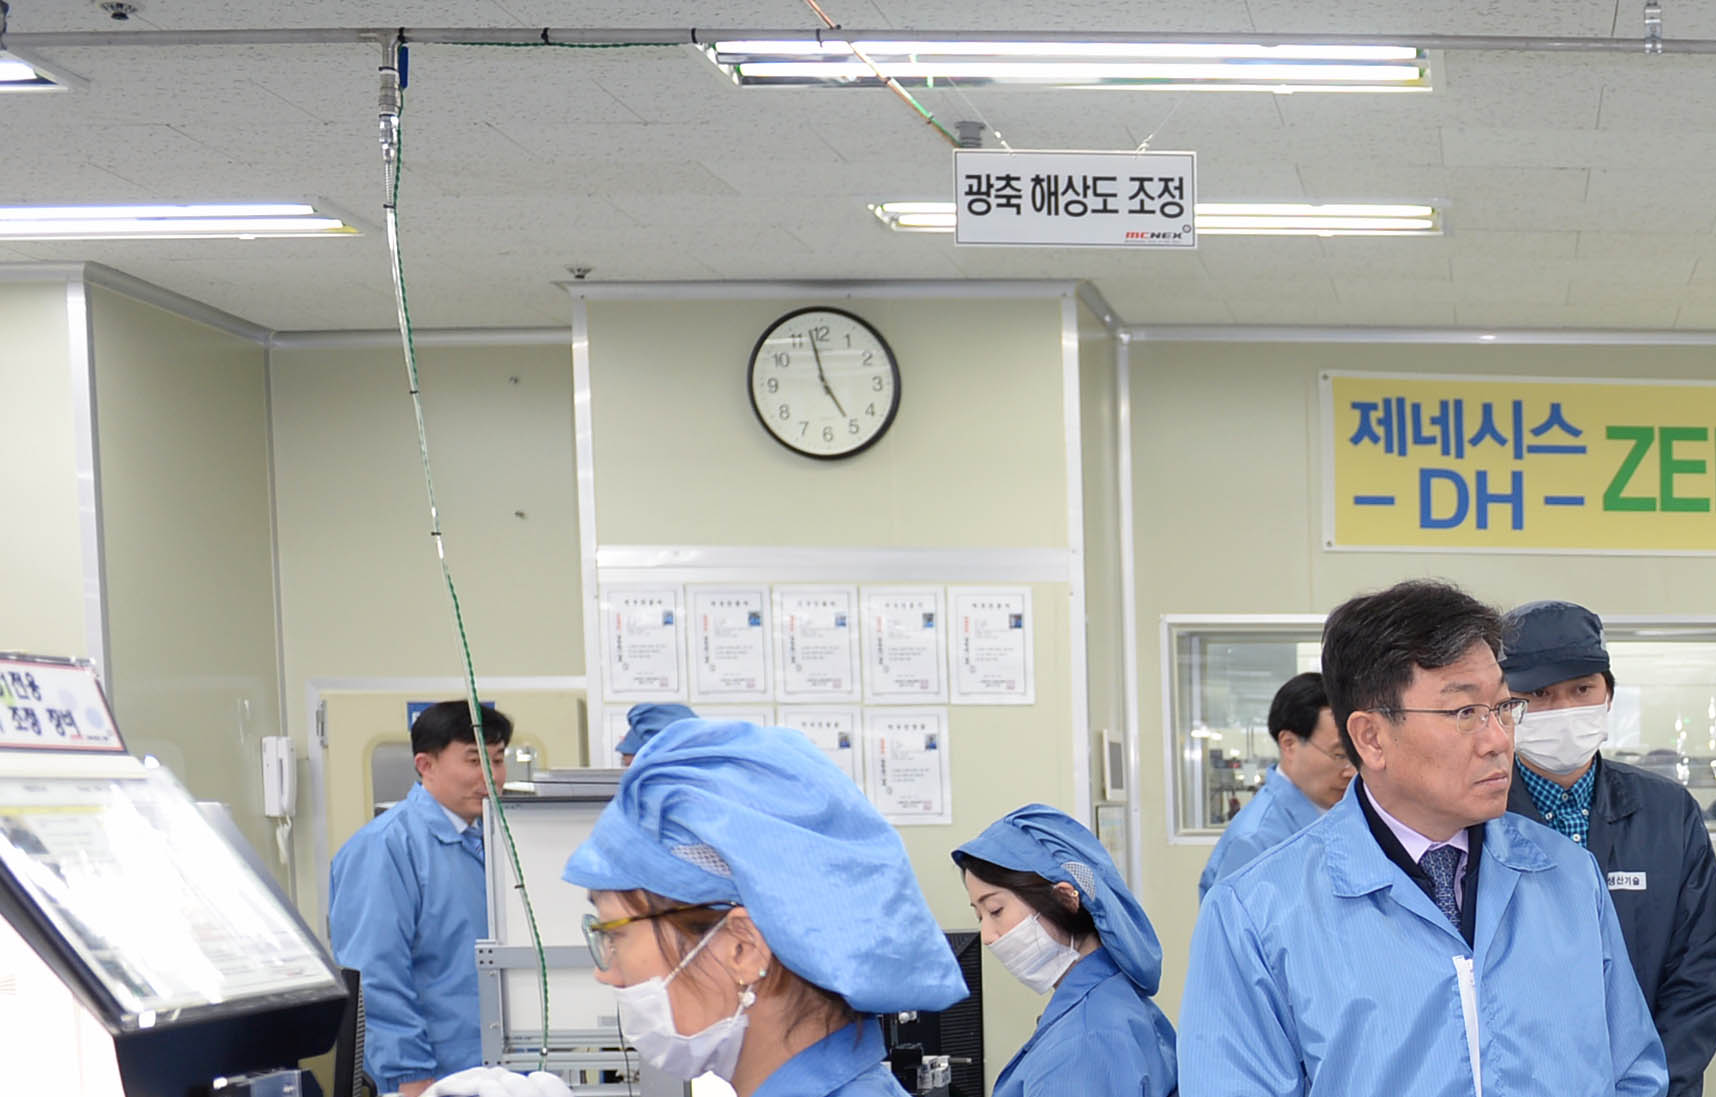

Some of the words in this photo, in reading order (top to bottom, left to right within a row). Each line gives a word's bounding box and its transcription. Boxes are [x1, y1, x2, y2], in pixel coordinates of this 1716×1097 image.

[964, 173, 1023, 216] 광축
[1030, 174, 1119, 218] 해상도
[1128, 176, 1185, 219] 조정
[789, 332, 804, 349] 11
[813, 326, 830, 342] 12
[844, 333, 852, 348] 1
[772, 352, 791, 368] 10
[861, 351, 873, 367] 2
[767, 377, 779, 394] 9
[872, 376, 883, 392] 3
[778, 404, 791, 420] 8
[864, 402, 875, 418] 4
[798, 420, 809, 436] 7
[822, 425, 834, 442] 6
[848, 418, 860, 435] 5
[1349, 396, 1587, 460] 제네시스
[1418, 467, 1524, 531] DH
[9, 705, 42, 736] 조정
[46, 707, 81, 737] 장비
